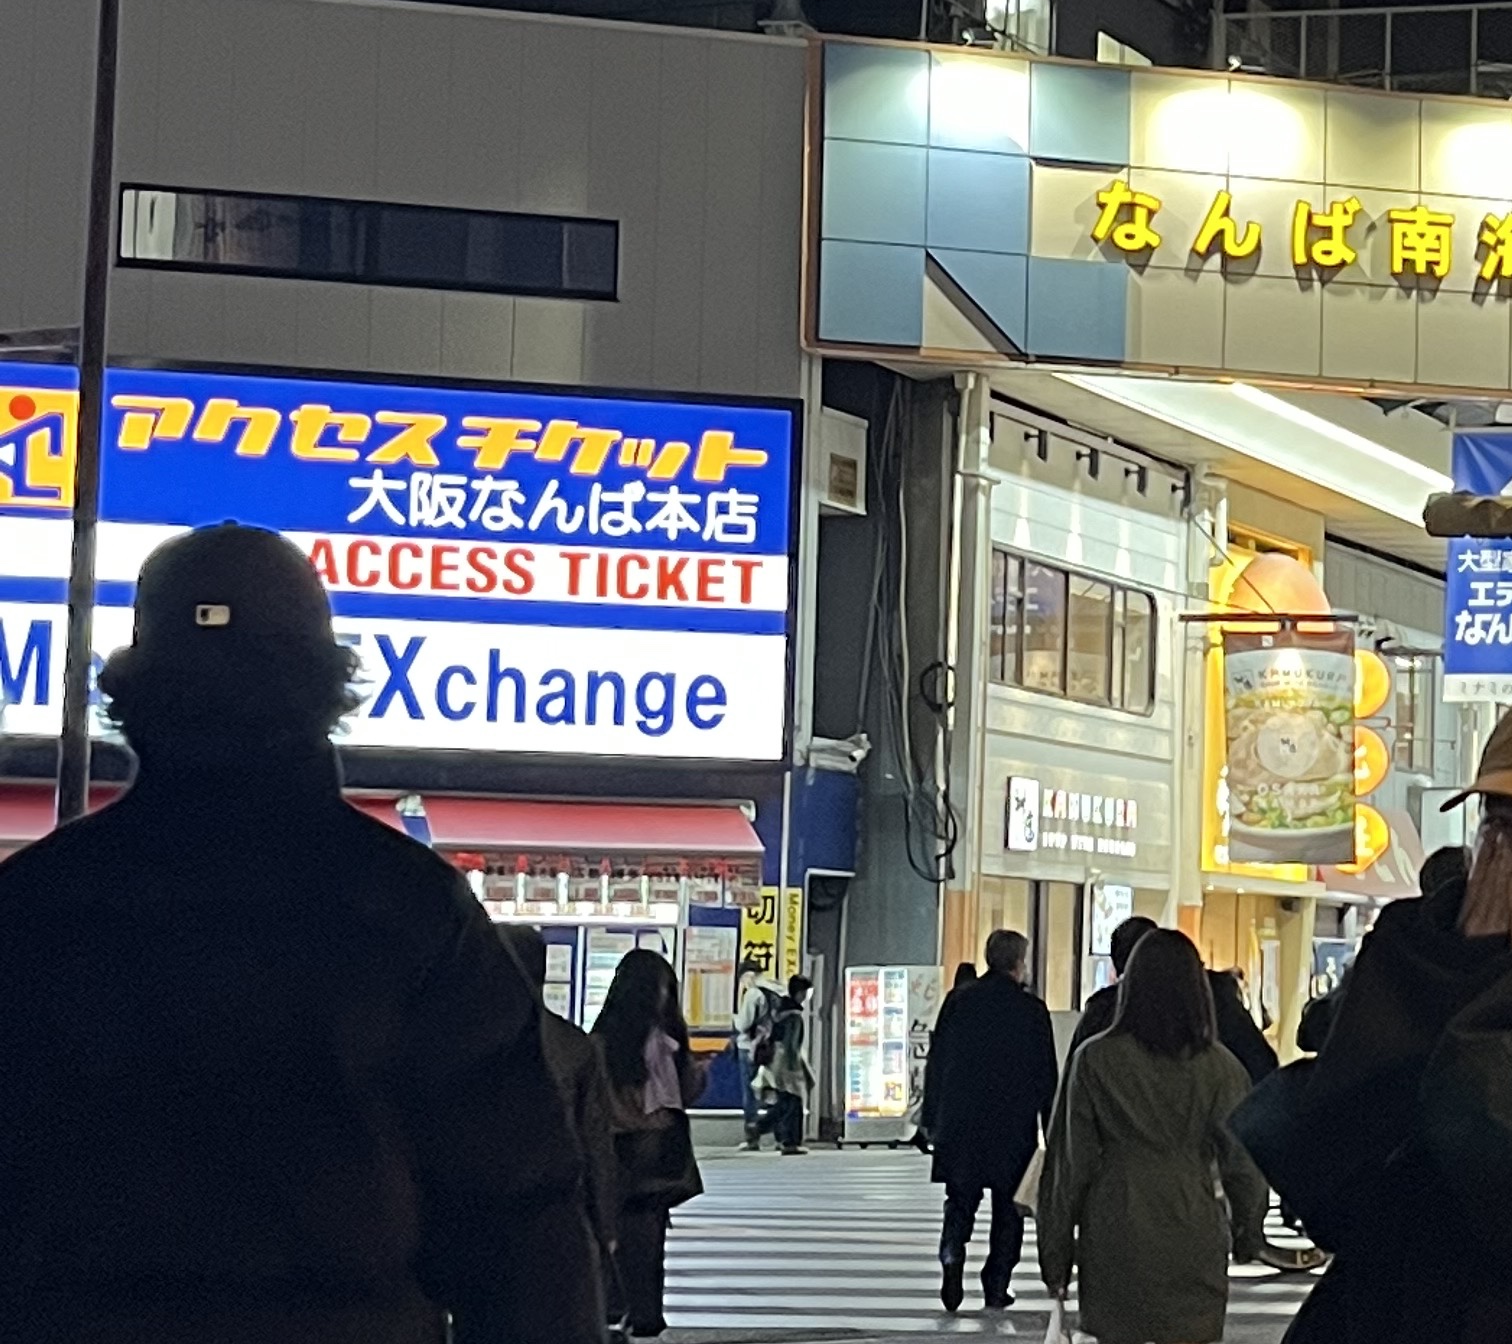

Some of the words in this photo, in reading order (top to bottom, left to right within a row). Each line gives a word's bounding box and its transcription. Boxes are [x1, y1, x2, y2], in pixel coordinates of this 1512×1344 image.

[111, 393, 769, 484] アクセスチケット
[347, 472, 760, 544] 大阪なんば本店
[311, 538, 537, 597] ACCESS
[558, 551, 765, 605] TICKET
[337, 632, 730, 737] Xchange
